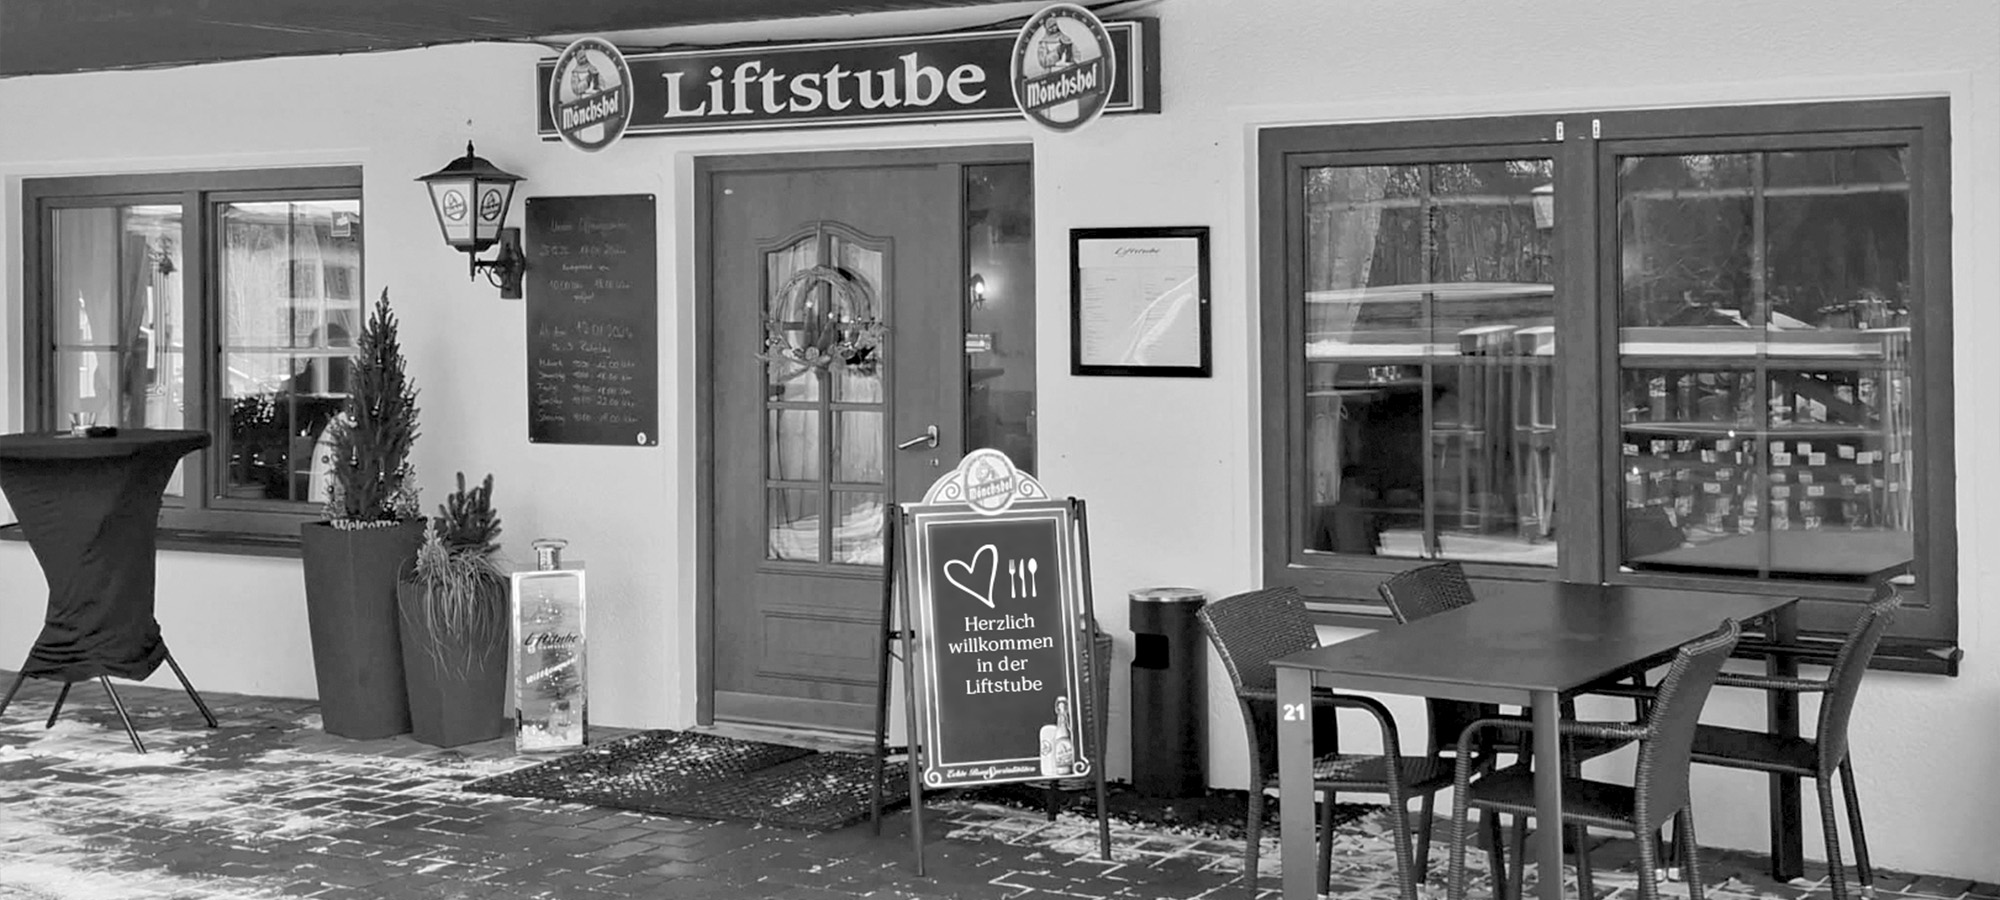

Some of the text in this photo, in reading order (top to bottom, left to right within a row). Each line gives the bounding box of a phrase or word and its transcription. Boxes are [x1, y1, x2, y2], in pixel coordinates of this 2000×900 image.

[661, 51, 986, 118] Liftstube
[1027, 62, 1098, 109] Mönchshof
[562, 90, 619, 130] Mönchshof
[964, 613, 1035, 632] Herzlich
[948, 636, 1054, 654] willkommen
[977, 655, 1028, 673] in der
[965, 676, 1043, 695] Liftstube
[1283, 703, 1305, 721] 21
